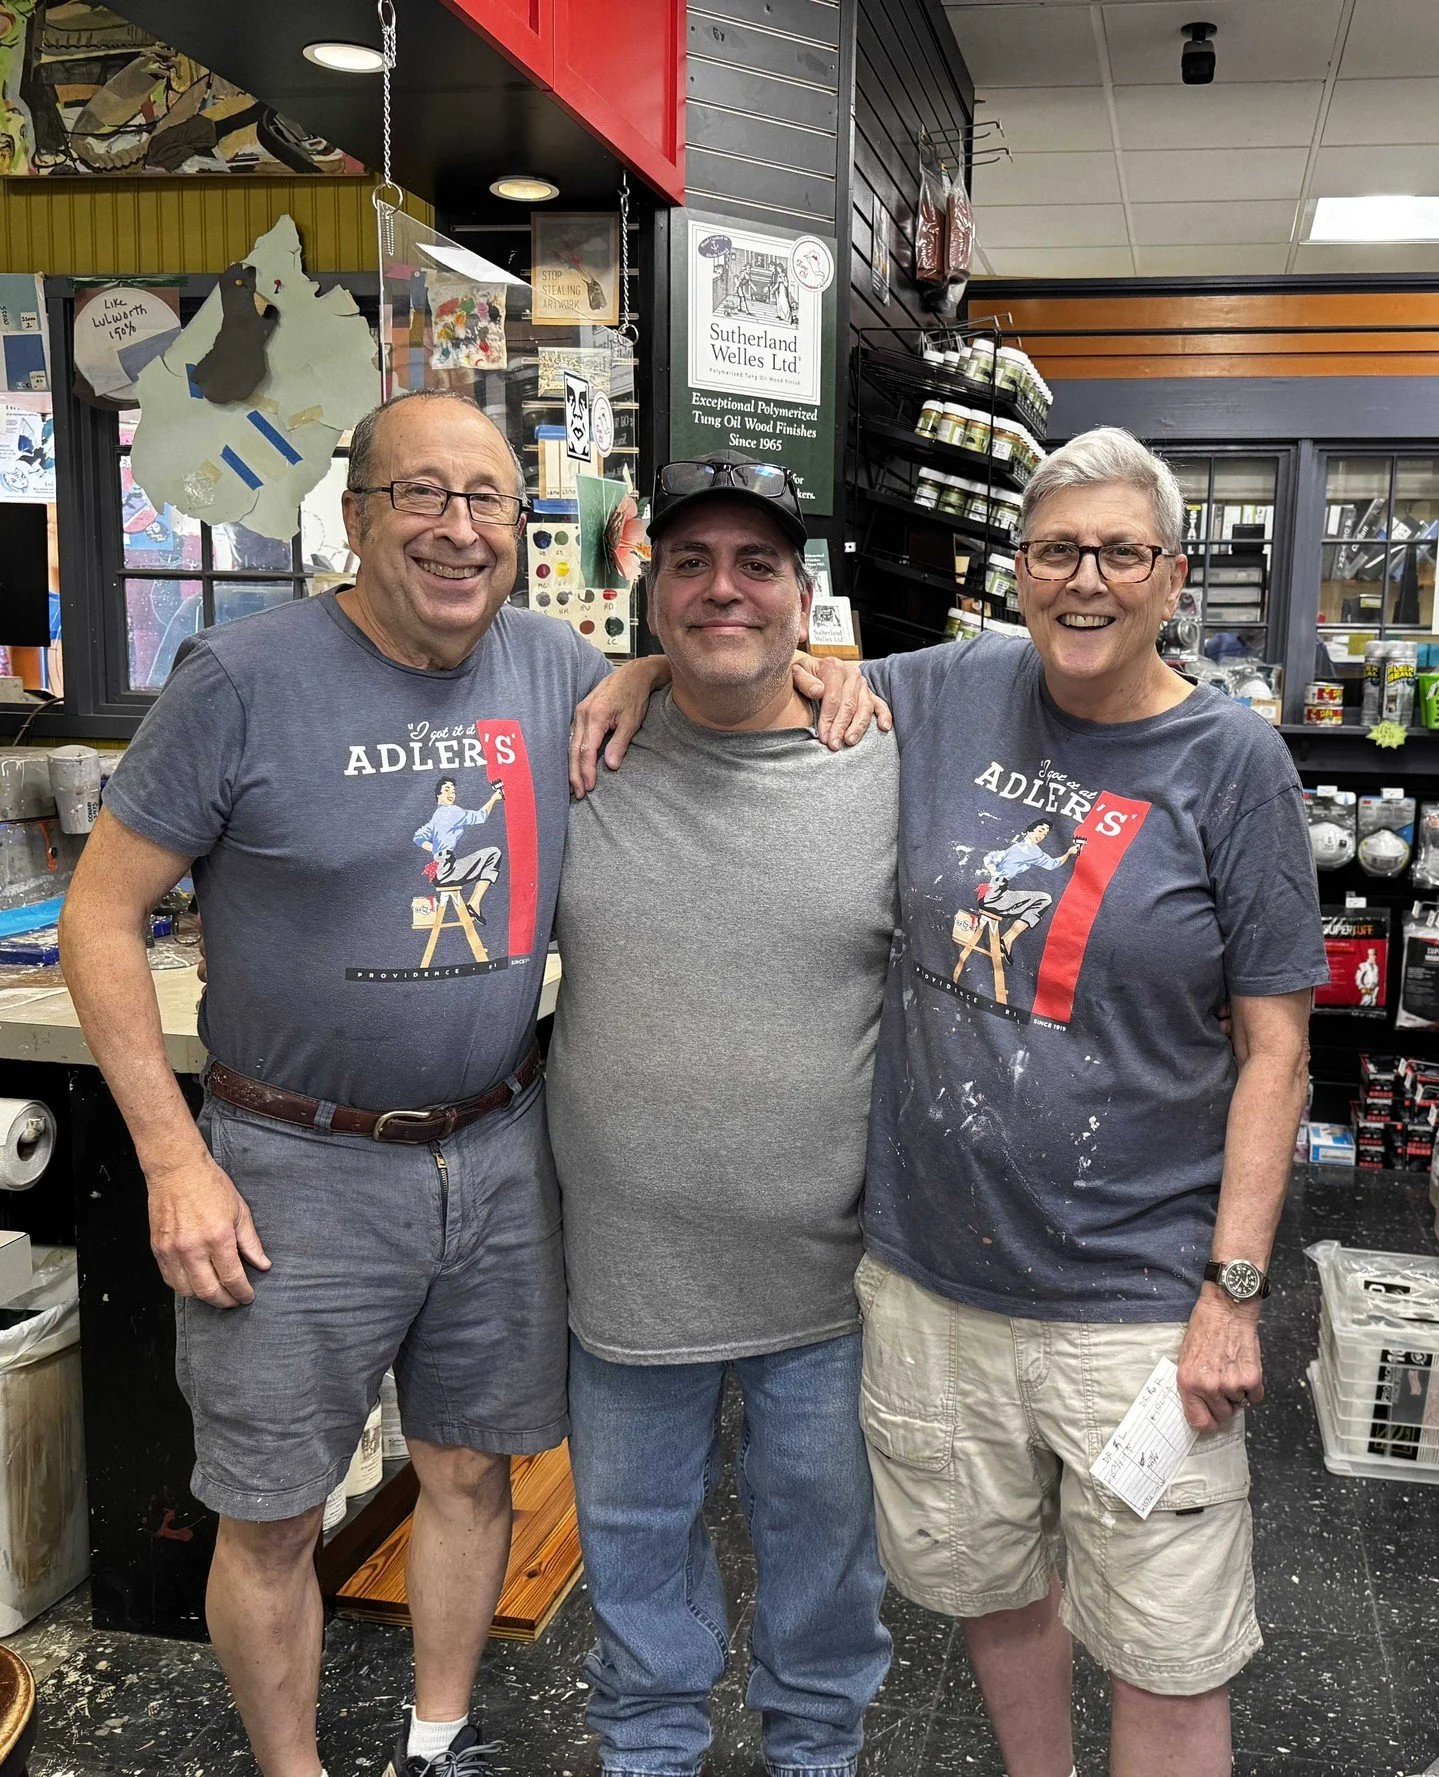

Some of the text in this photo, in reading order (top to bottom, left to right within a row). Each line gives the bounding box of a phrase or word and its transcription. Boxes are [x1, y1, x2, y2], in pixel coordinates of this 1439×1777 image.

[542, 270, 562, 281] STOP
[542, 285, 581, 296] STEALING
[543, 299, 580, 310] ARTWORK
[709, 322, 797, 353] Sutherland
[710, 343, 764, 368] Welles
[691, 392, 818, 422] Exceptional Polymerized
[692, 410, 817, 438] Tung Oil Wood Finishes
[729, 433, 782, 451] Since 1965
[428, 727, 449, 747] got
[452, 724, 465, 736] it
[1078, 790, 1098, 800] at
[357, 968, 460, 978] PROVIDENCE
[1033, 1018, 1052, 1028] SINCE
